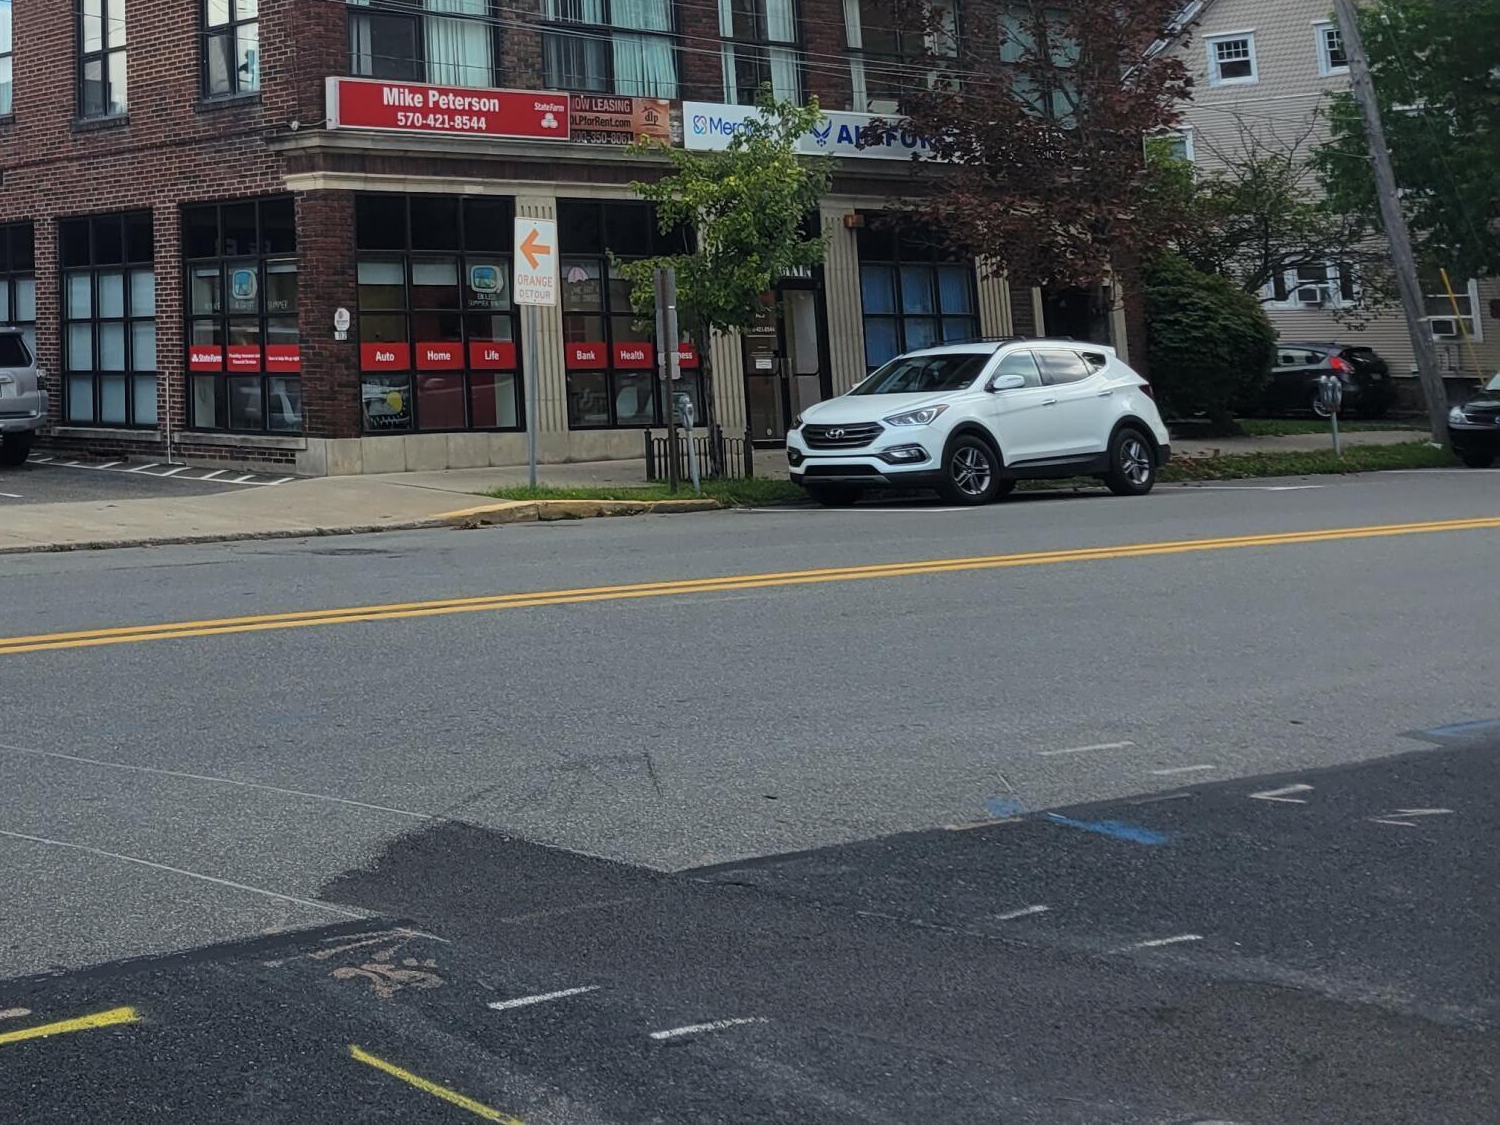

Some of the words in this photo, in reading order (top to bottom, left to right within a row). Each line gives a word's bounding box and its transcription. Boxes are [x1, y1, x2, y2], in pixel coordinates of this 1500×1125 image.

[383, 87, 423, 107] Mike
[428, 89, 500, 112] Peterson
[592, 98, 630, 112] LEASING
[397, 112, 486, 131] 570-421-8544
[644, 112, 658, 125] dlp
[517, 275, 553, 288] ORANGE
[520, 289, 550, 299] DETOUR
[376, 351, 394, 361] Auto
[428, 351, 450, 361] Home
[484, 350, 500, 361] Life
[576, 351, 596, 360] Bank
[620, 351, 644, 360] Health
